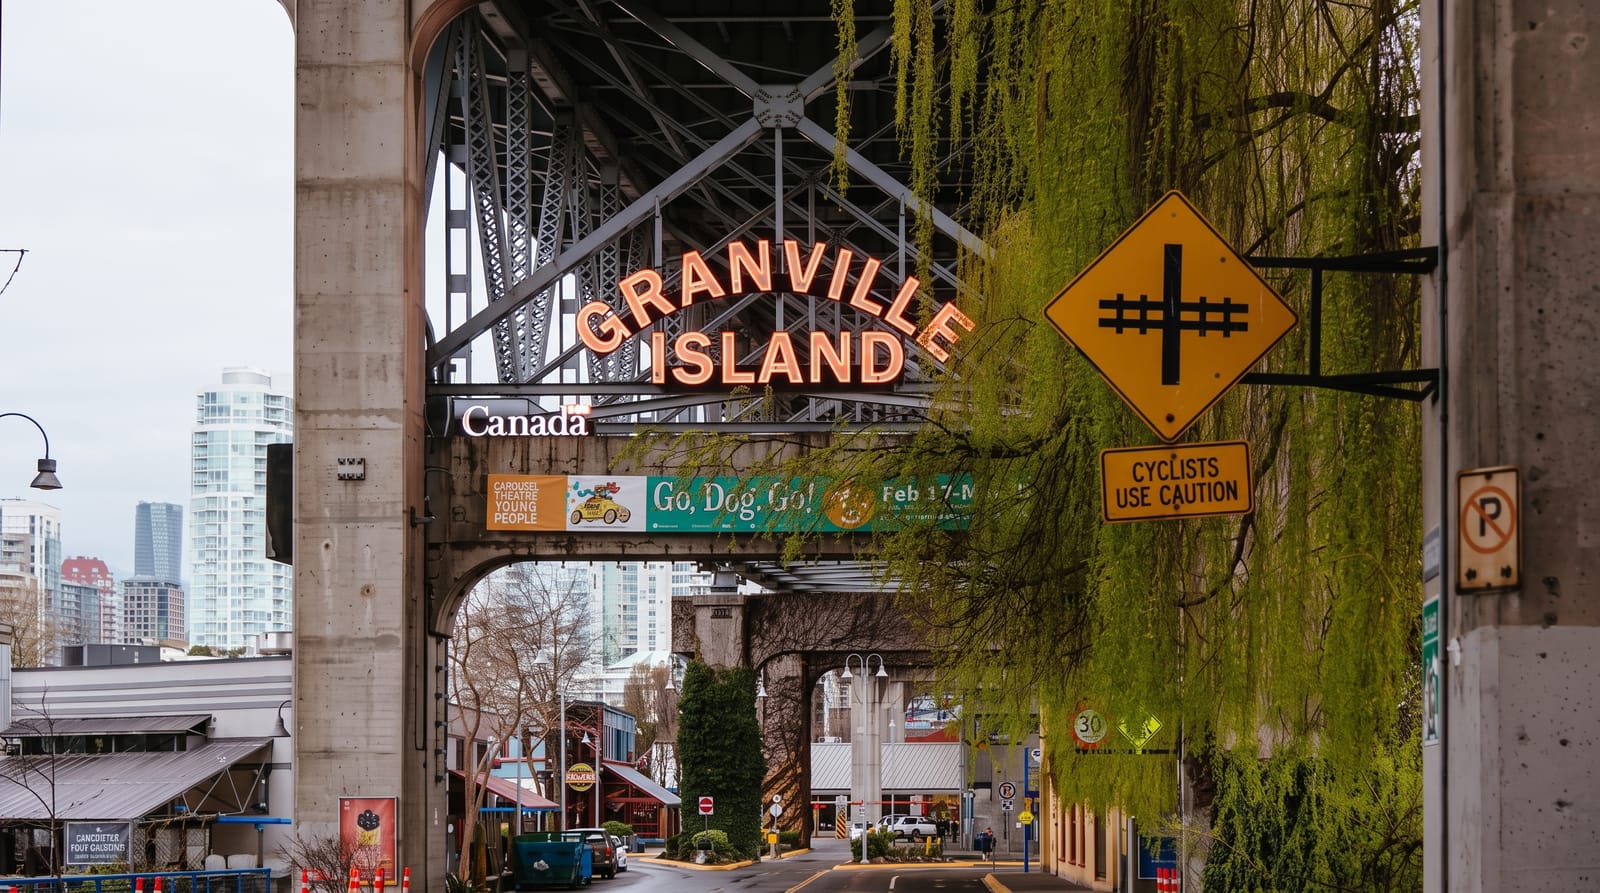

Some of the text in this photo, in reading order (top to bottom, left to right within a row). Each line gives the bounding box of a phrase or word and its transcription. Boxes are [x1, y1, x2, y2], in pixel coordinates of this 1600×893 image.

[576, 240, 976, 363] GRANVILLE
[651, 331, 905, 385] ISLAND
[462, 405, 588, 437] Canada
[1132, 457, 1219, 483] CYCLISTS
[494, 482, 539, 491] CAROUSEL
[494, 491, 538, 501] THEATRE
[654, 481, 695, 515] Go,
[768, 482, 815, 513] Go!
[883, 485, 919, 502] Feb
[1116, 480, 1238, 508] USE CAUTION
[494, 513, 537, 524] PEOPLE
[496, 501, 537, 512] YOUNG
[1080, 716, 1101, 733] 30
